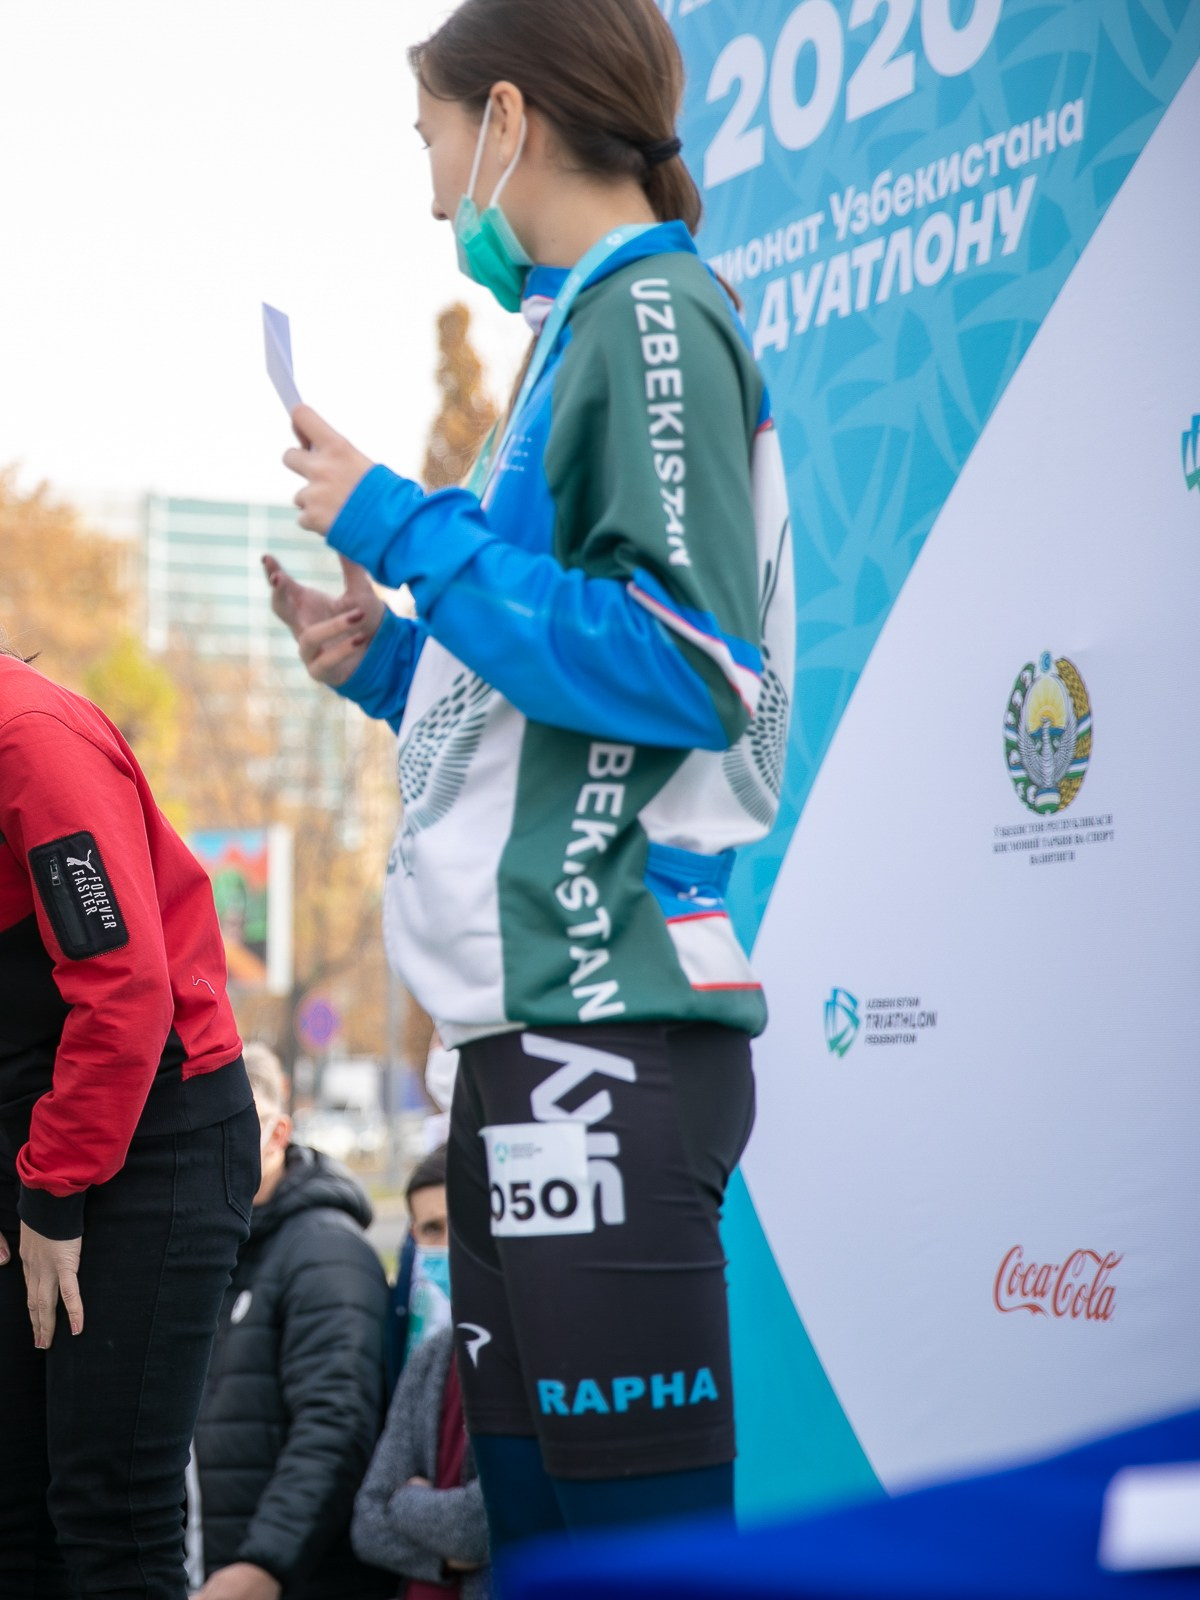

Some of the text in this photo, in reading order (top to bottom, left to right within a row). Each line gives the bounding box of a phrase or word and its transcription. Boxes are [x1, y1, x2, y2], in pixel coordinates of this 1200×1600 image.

[703, 0, 1001, 190] 2020
[829, 97, 1084, 242] Узбекистана
[753, 174, 1038, 361] ДУАТЛОНУ
[630, 277, 692, 567] UZBEKISTAN
[72, 869, 98, 916] FASTER
[88, 876, 117, 929] FOREVER
[491, 1178, 578, 1222] 050
[993, 1244, 1124, 1322] Coca-Cola
[536, 1367, 719, 1417] RAPHA
